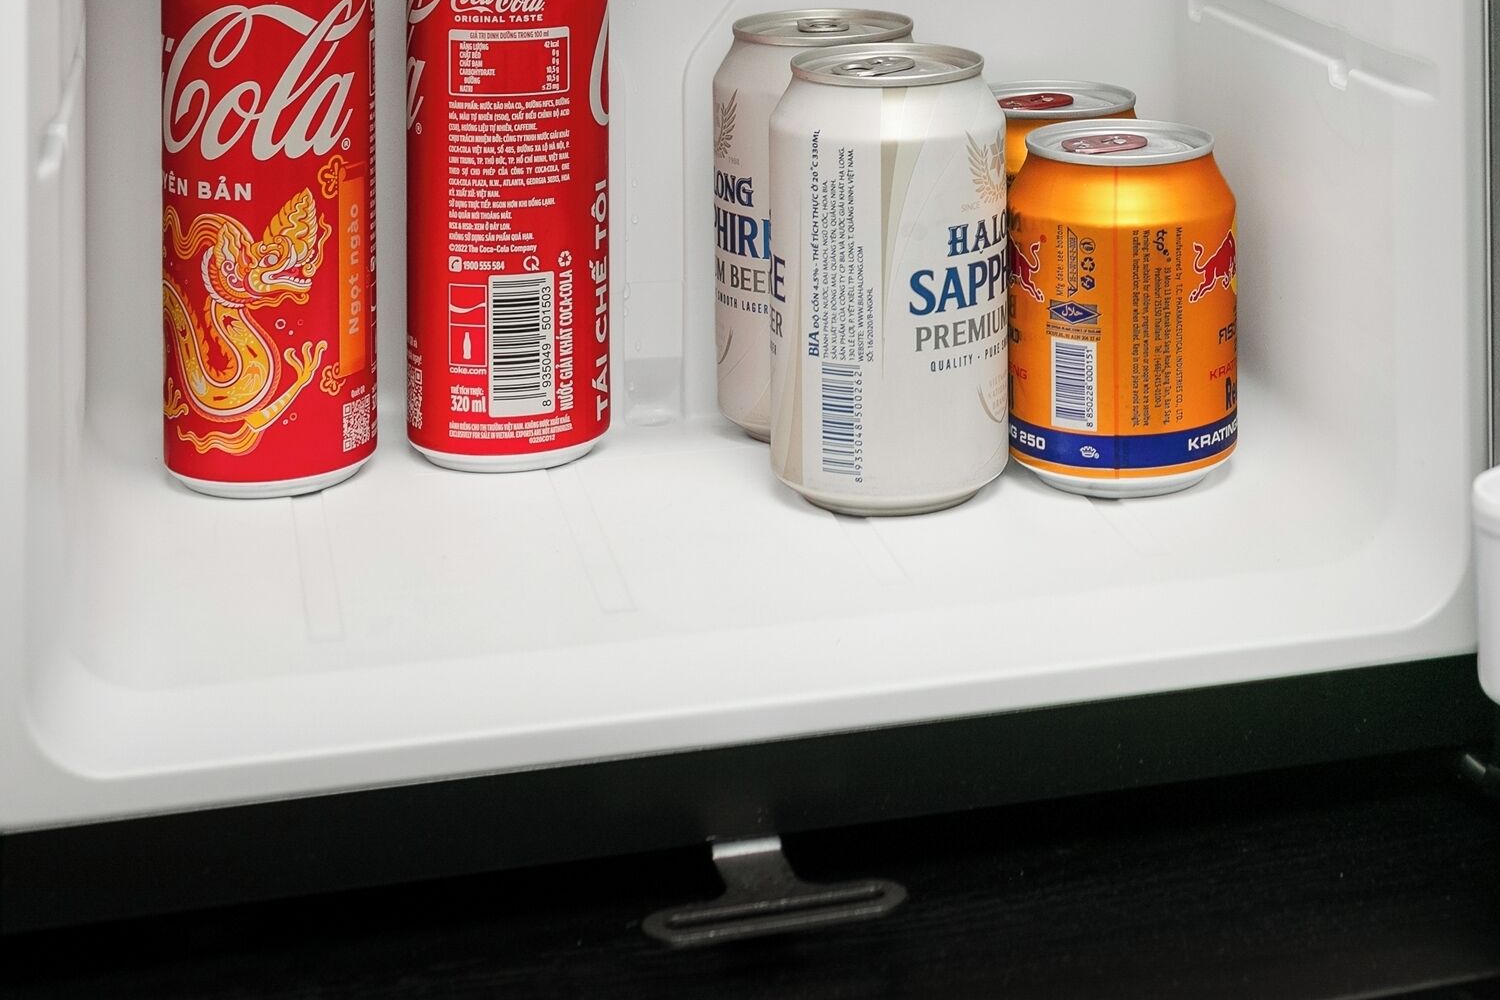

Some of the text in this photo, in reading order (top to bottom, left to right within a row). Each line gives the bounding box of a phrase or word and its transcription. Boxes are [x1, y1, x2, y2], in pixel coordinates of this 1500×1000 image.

[454, 14, 544, 23] ORIGINAL TASTE
[198, 175, 252, 201] BẢN
[480, 245, 509, 253] Coca-Cola
[510, 244, 538, 254] Company
[463, 260, 504, 270] 1900 555 584
[730, 263, 770, 294] BEE
[542, 286, 551, 330] 501503
[589, 179, 608, 421] TÁI CHẾ TÔI
[742, 300, 769, 314] LAGER
[555, 270, 573, 412] NƯỚC GIẢI KHÁT COCA-COLA
[808, 331, 820, 357] BIA
[450, 366, 487, 375] coke.com
[542, 343, 551, 388] 935049
[930, 354, 973, 372] QUALITY
[451, 396, 486, 412] 320 ml
[1086, 385, 1094, 418] 850228
[1020, 430, 1046, 450] 250
